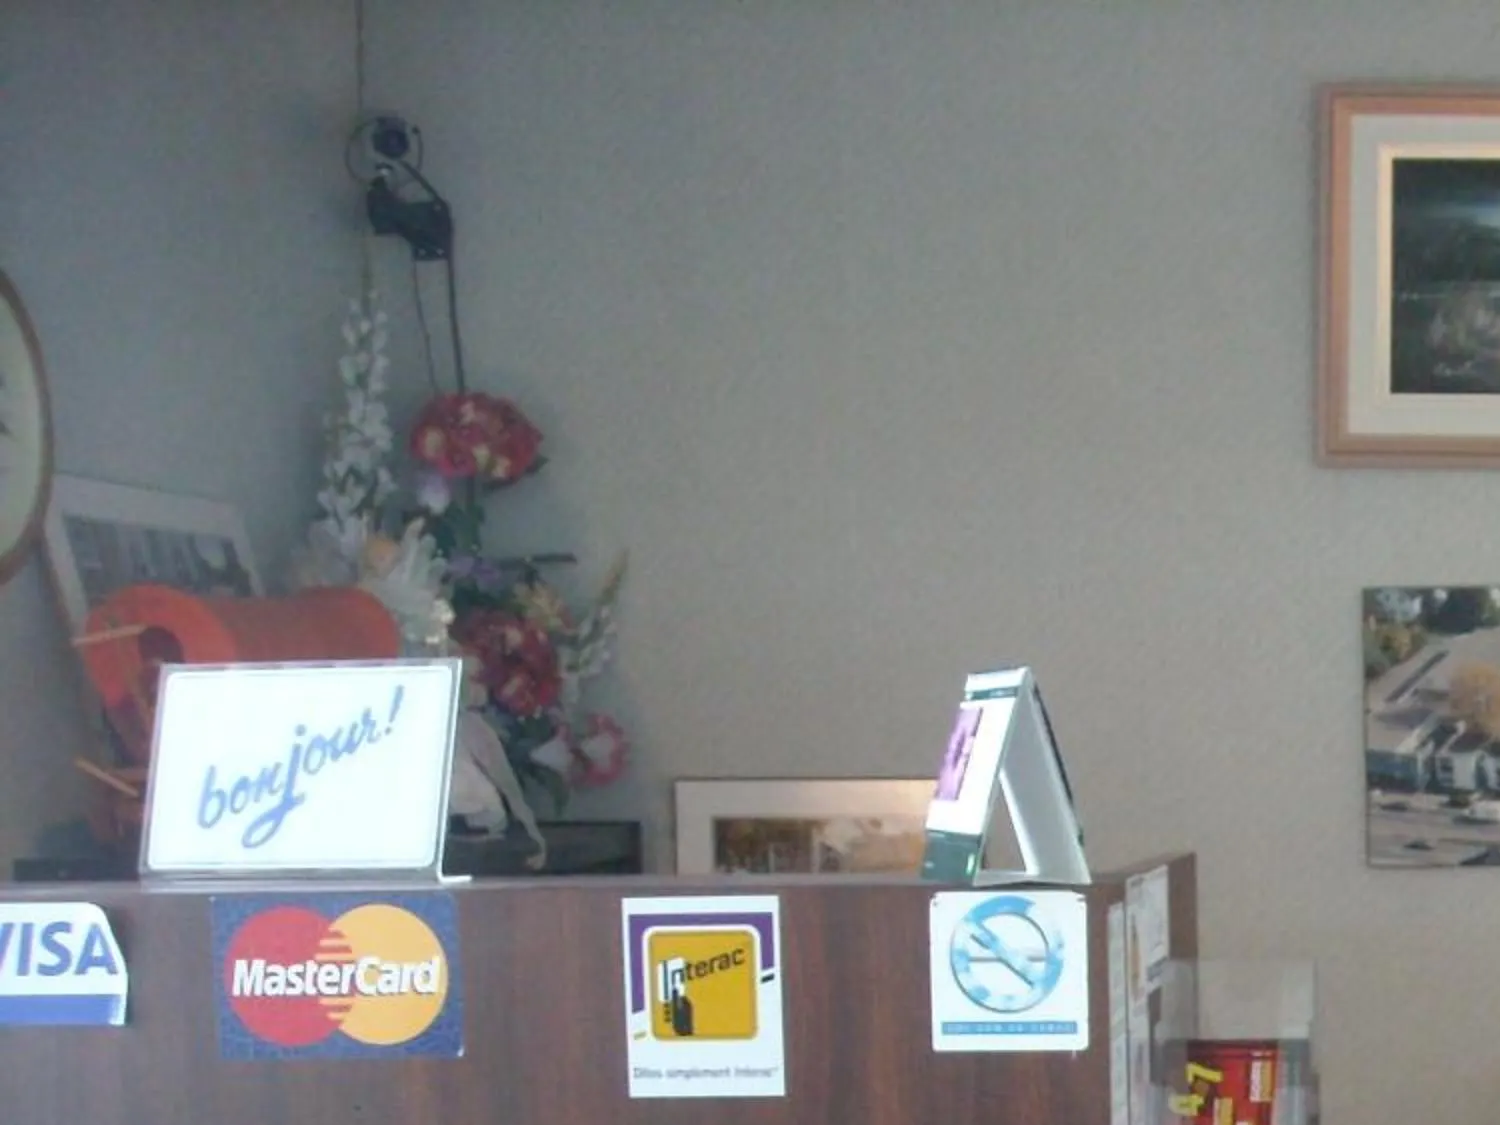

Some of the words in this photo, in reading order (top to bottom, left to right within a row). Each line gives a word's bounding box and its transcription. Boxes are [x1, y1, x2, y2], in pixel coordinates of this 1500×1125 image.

[197, 685, 405, 848] bonjour!
[231, 955, 442, 998] MasterCard
[663, 947, 746, 1001] Interac
